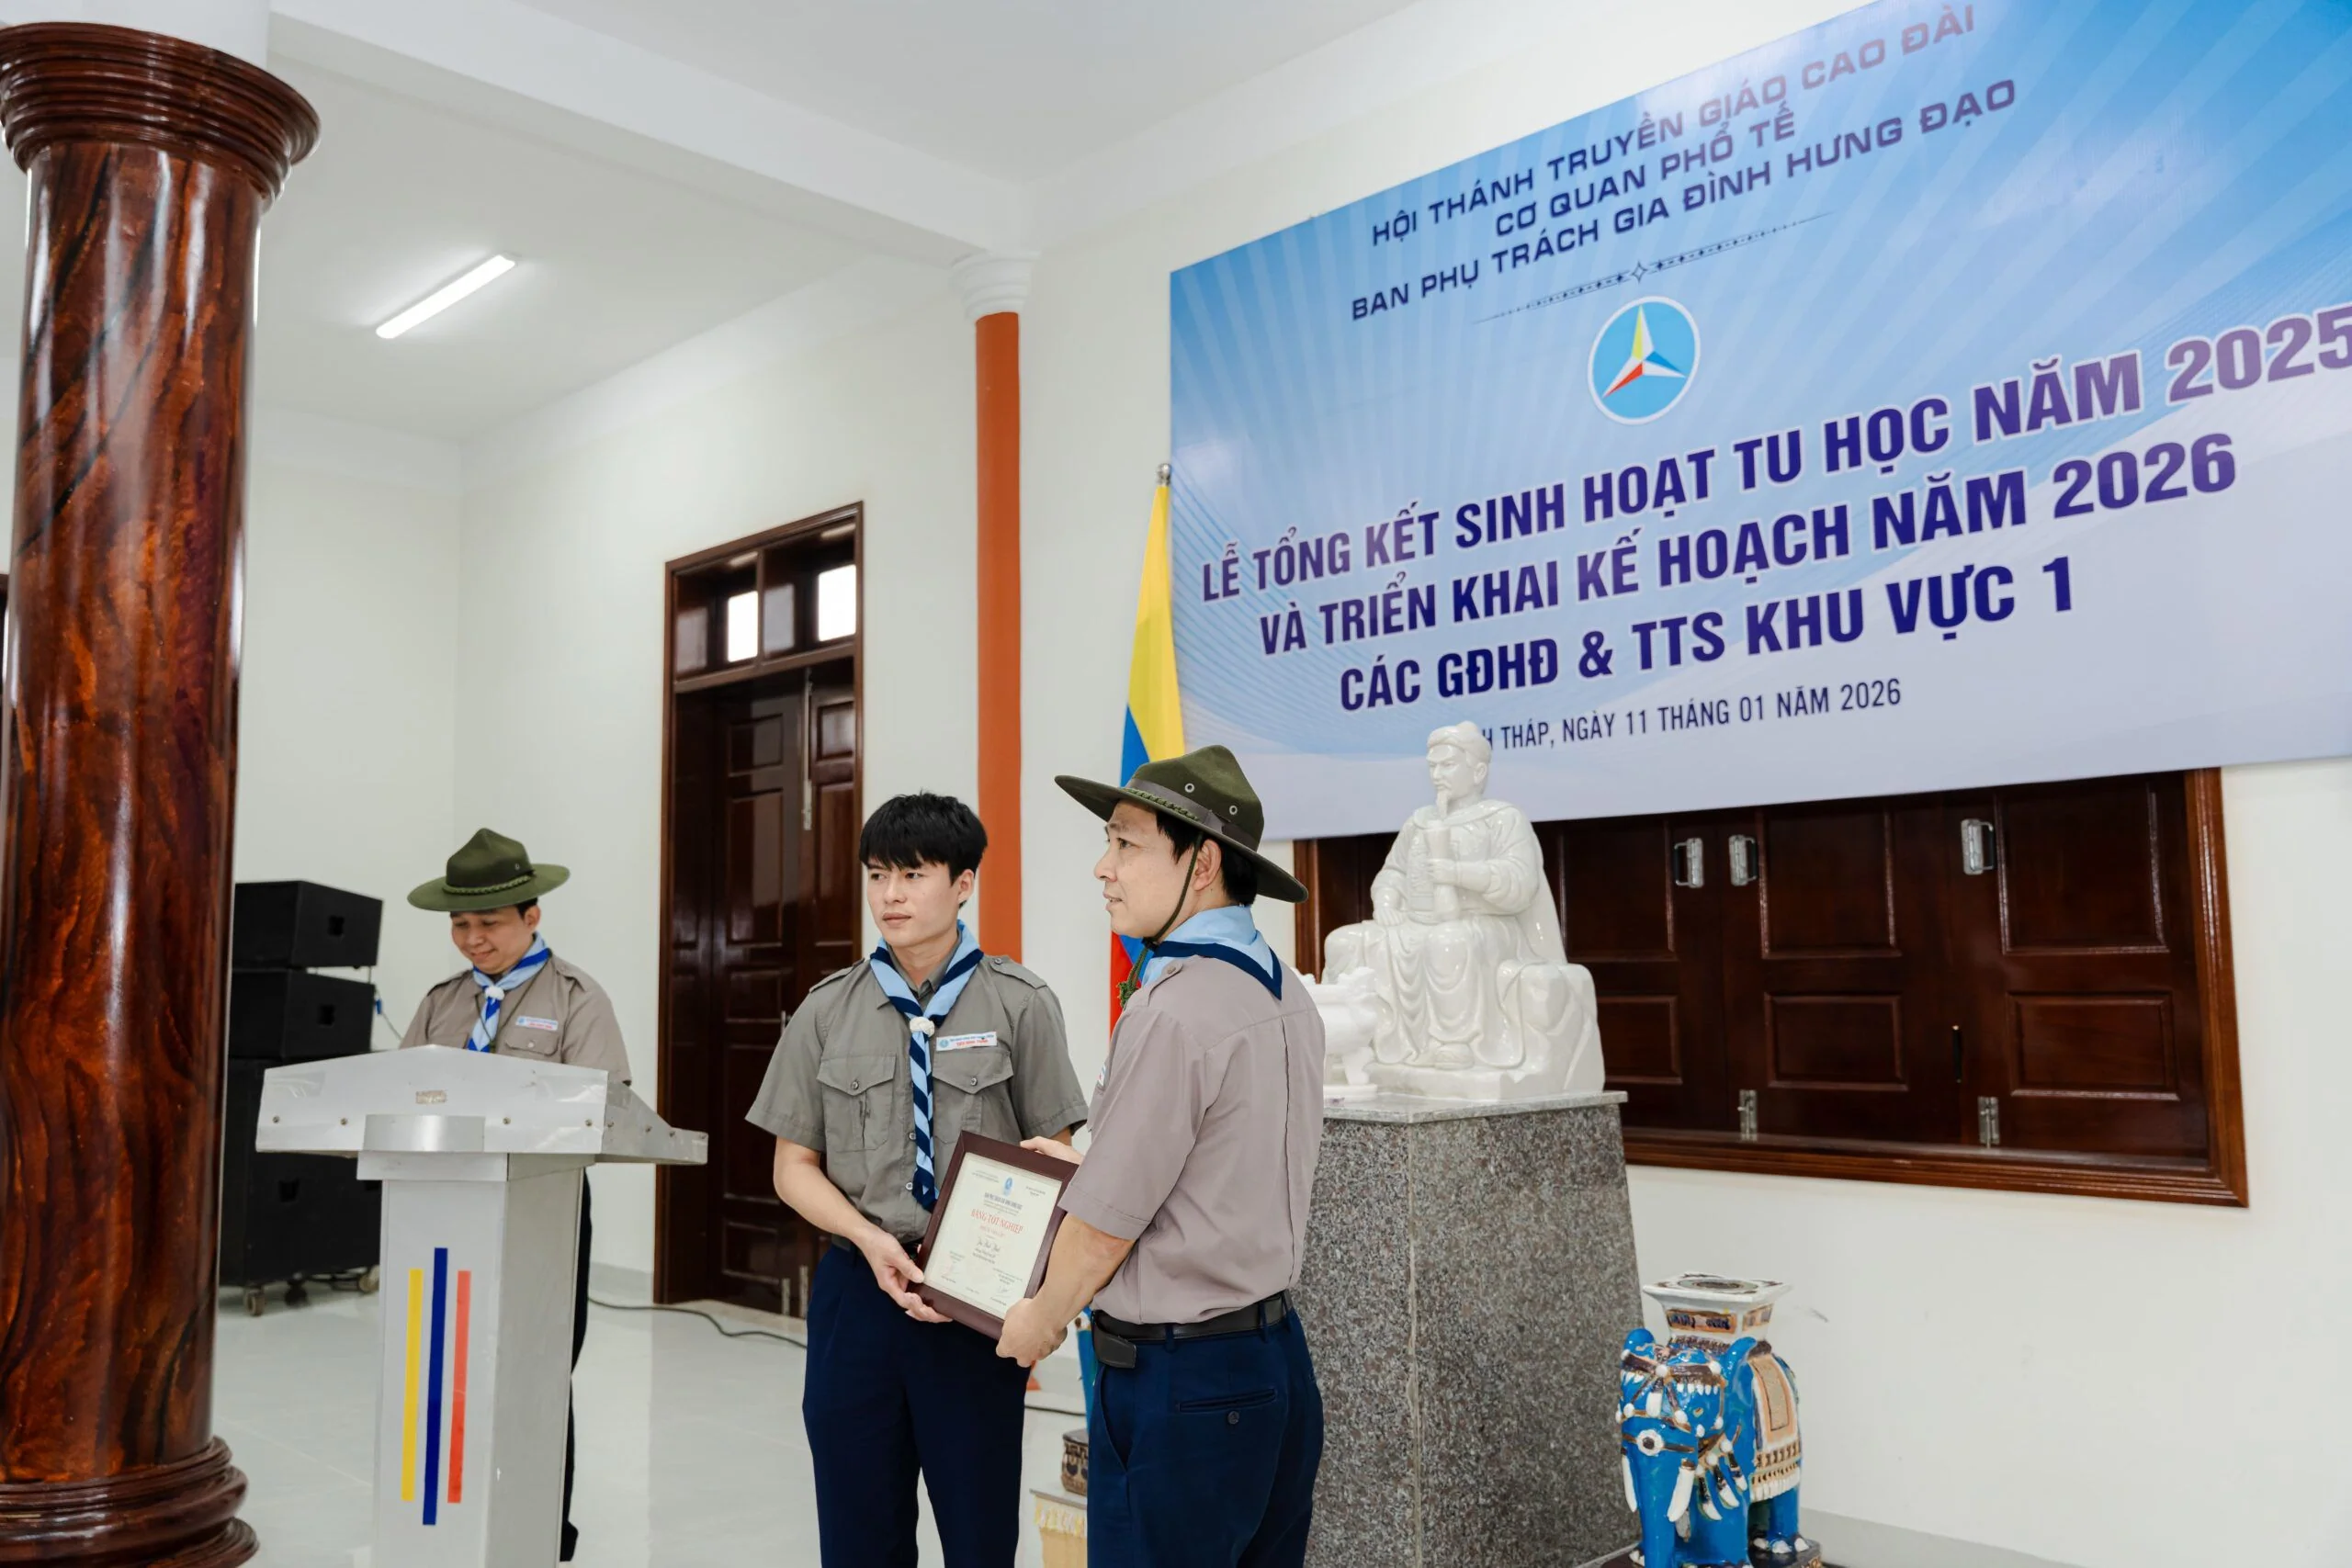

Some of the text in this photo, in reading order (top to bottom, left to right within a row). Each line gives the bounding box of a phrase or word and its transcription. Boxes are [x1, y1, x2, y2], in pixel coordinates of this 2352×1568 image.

[1351, 78, 2017, 321] BAN PHỤ TRÁCH GIA ĐÌNH HƯNG ĐẠO
[1373, 4, 1974, 246] HỘI THÁNH TRUYỀN GIÁO CAO ĐÀI
[1496, 99, 1797, 237] CƠ QUAN PHỔ TẾ
[1203, 306, 2352, 601] LỄ TỔNG KẾT SINH HOẠT TU HỌC NĂM 2025
[1260, 434, 2237, 655] VÀ TRIỂN KHAI KẾ HOẠCH NĂM 2026
[1340, 556, 2072, 711] CÁC GĐHĐ & TTS KHU VỰC 1
[1500, 718, 1555, 750] THÁP,
[1562, 710, 1615, 742] NGÀY
[1625, 709, 1647, 735] 11
[1657, 698, 1730, 731] THÁNG
[1739, 695, 1764, 722] 01
[1776, 686, 1830, 718] NĂM
[1840, 678, 1902, 710] 2026
